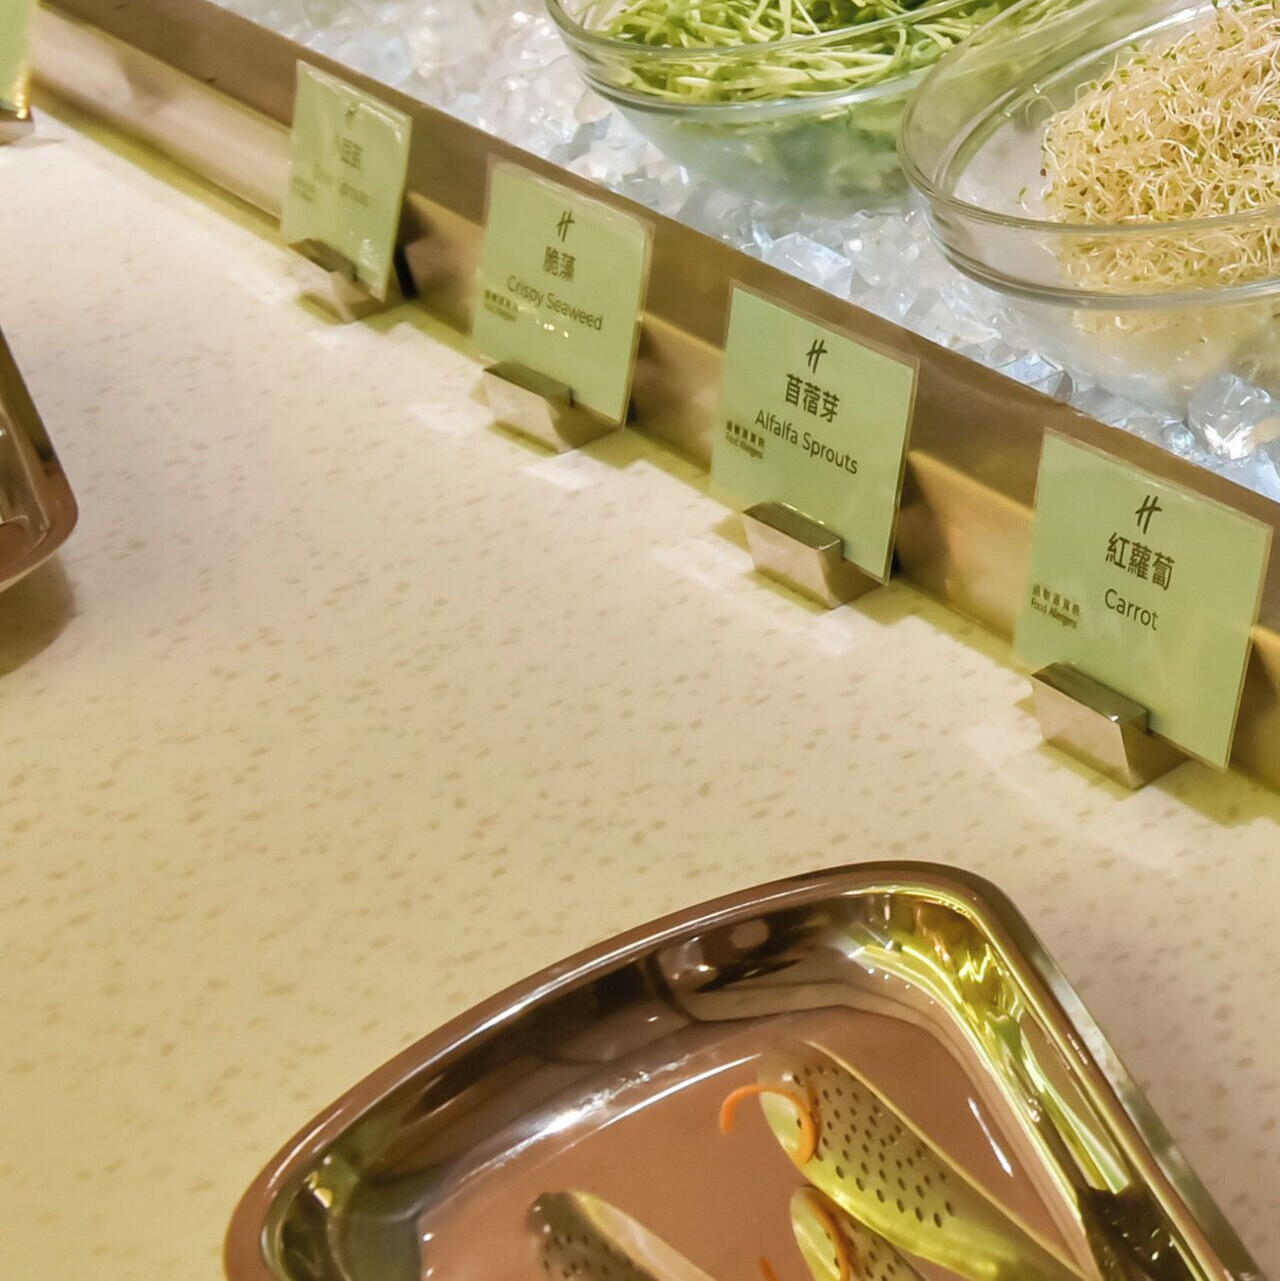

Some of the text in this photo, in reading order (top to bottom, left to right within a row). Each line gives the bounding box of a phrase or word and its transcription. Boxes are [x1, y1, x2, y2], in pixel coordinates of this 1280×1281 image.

[507, 275, 544, 309] Crispy
[546, 292, 603, 331] Seaweed
[785, 373, 841, 424] 苜蓿芽
[755, 409, 799, 446] Alfalfa
[802, 431, 859, 476] Sprouts
[1105, 532, 1176, 591] 紅蘿蔔
[1104, 588, 1159, 631] Carrot
